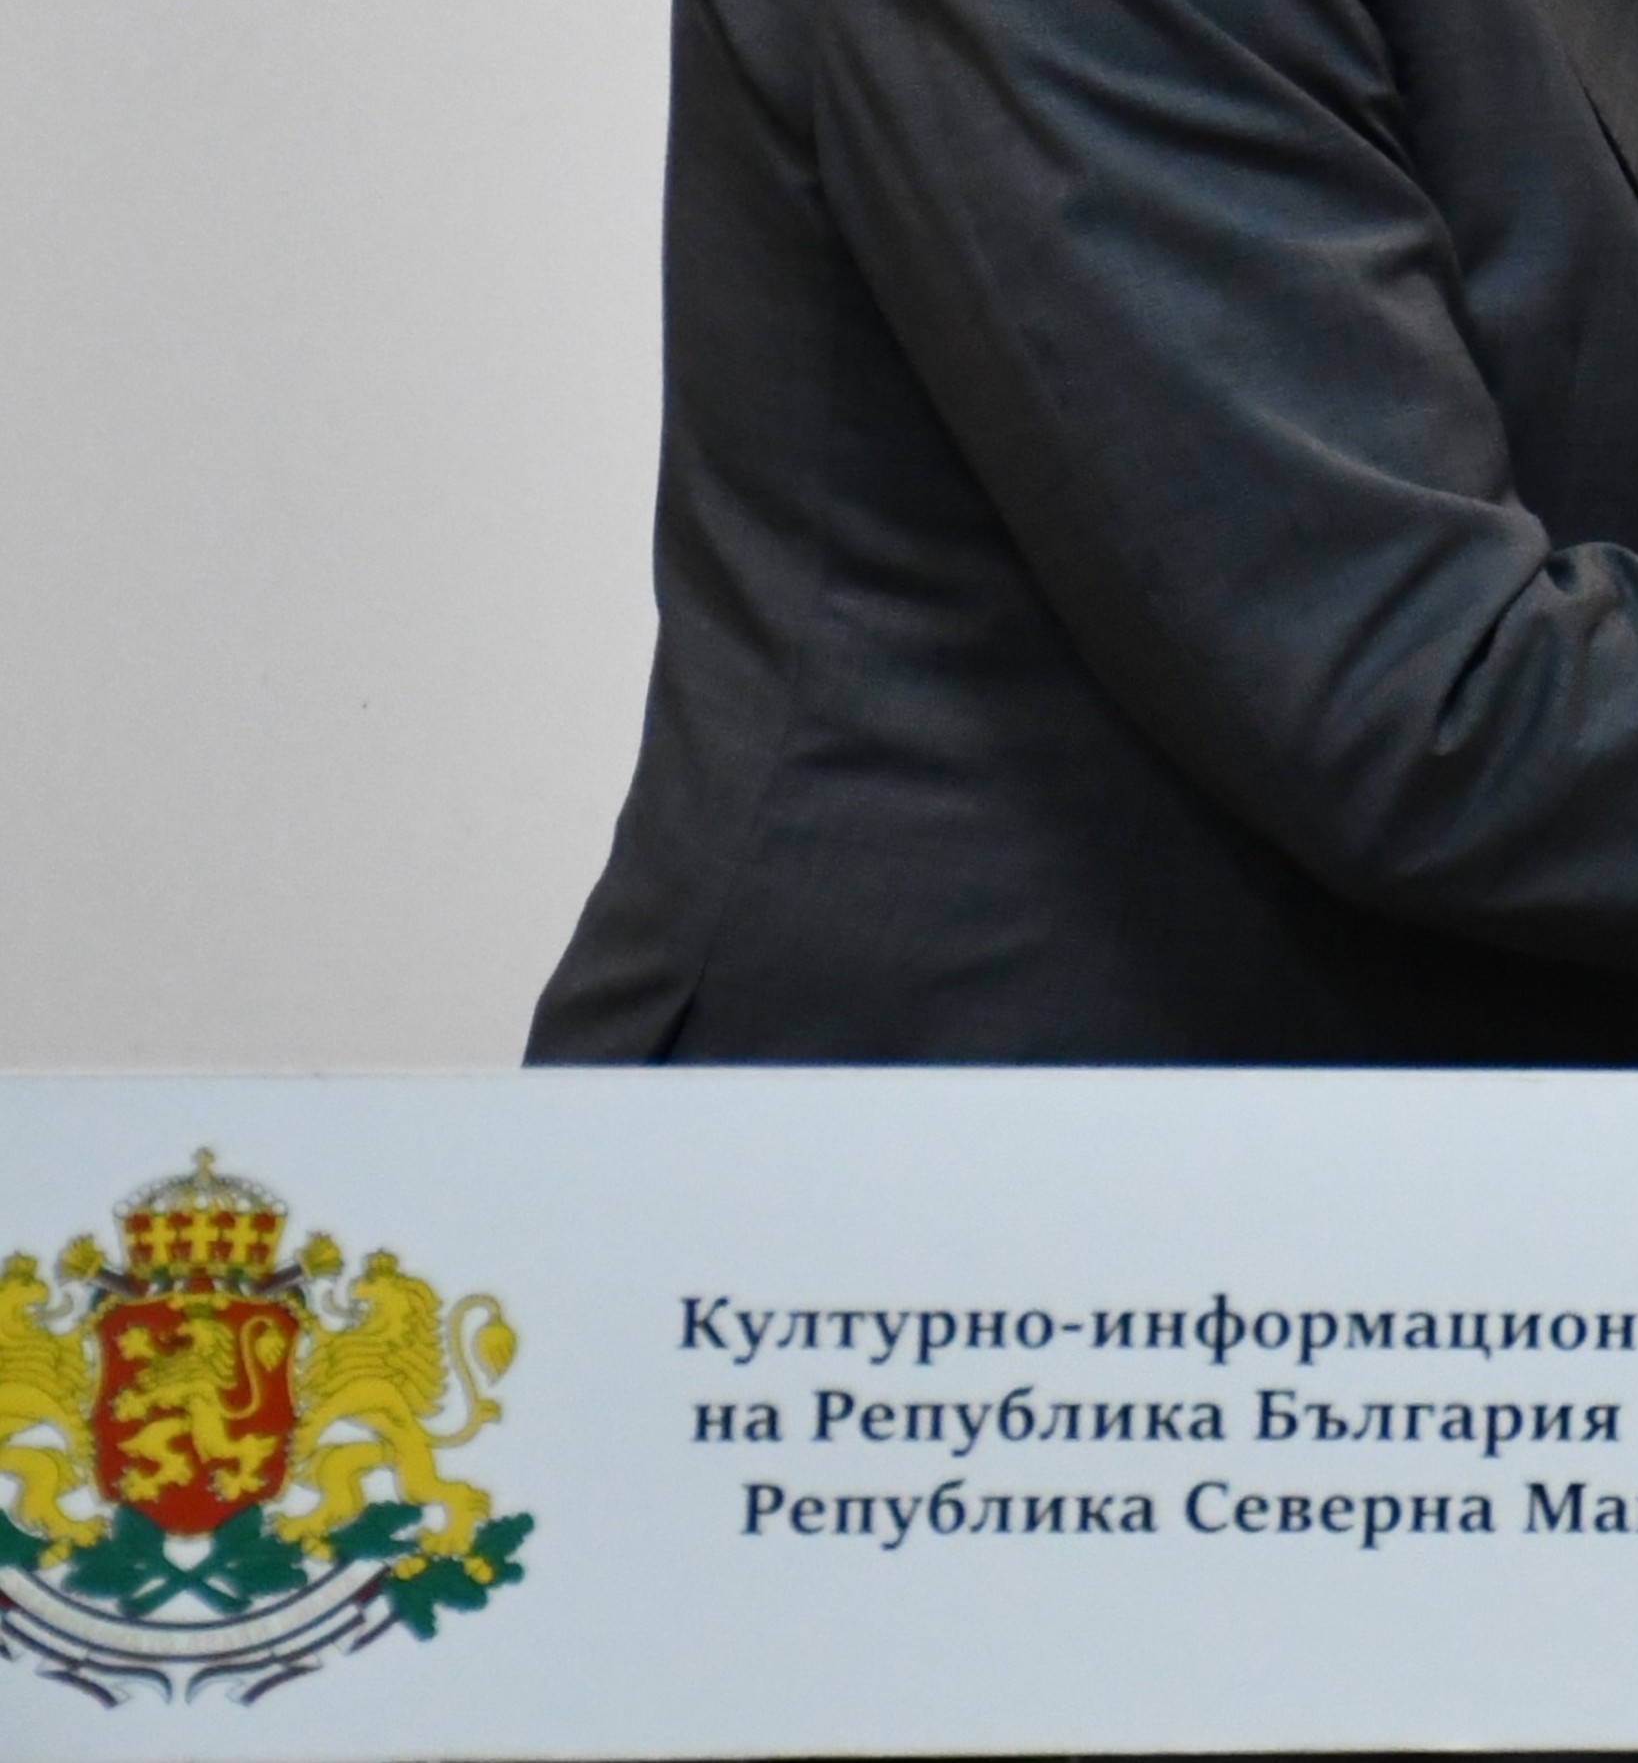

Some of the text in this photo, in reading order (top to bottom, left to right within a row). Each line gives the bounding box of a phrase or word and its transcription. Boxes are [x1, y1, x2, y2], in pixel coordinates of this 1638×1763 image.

[692, 1400, 784, 1443] на
[811, 1385, 1226, 1458] Република
[1254, 1386, 1622, 1458] България
[739, 1477, 1159, 1551] Република
[1183, 1478, 1497, 1550] Северна
